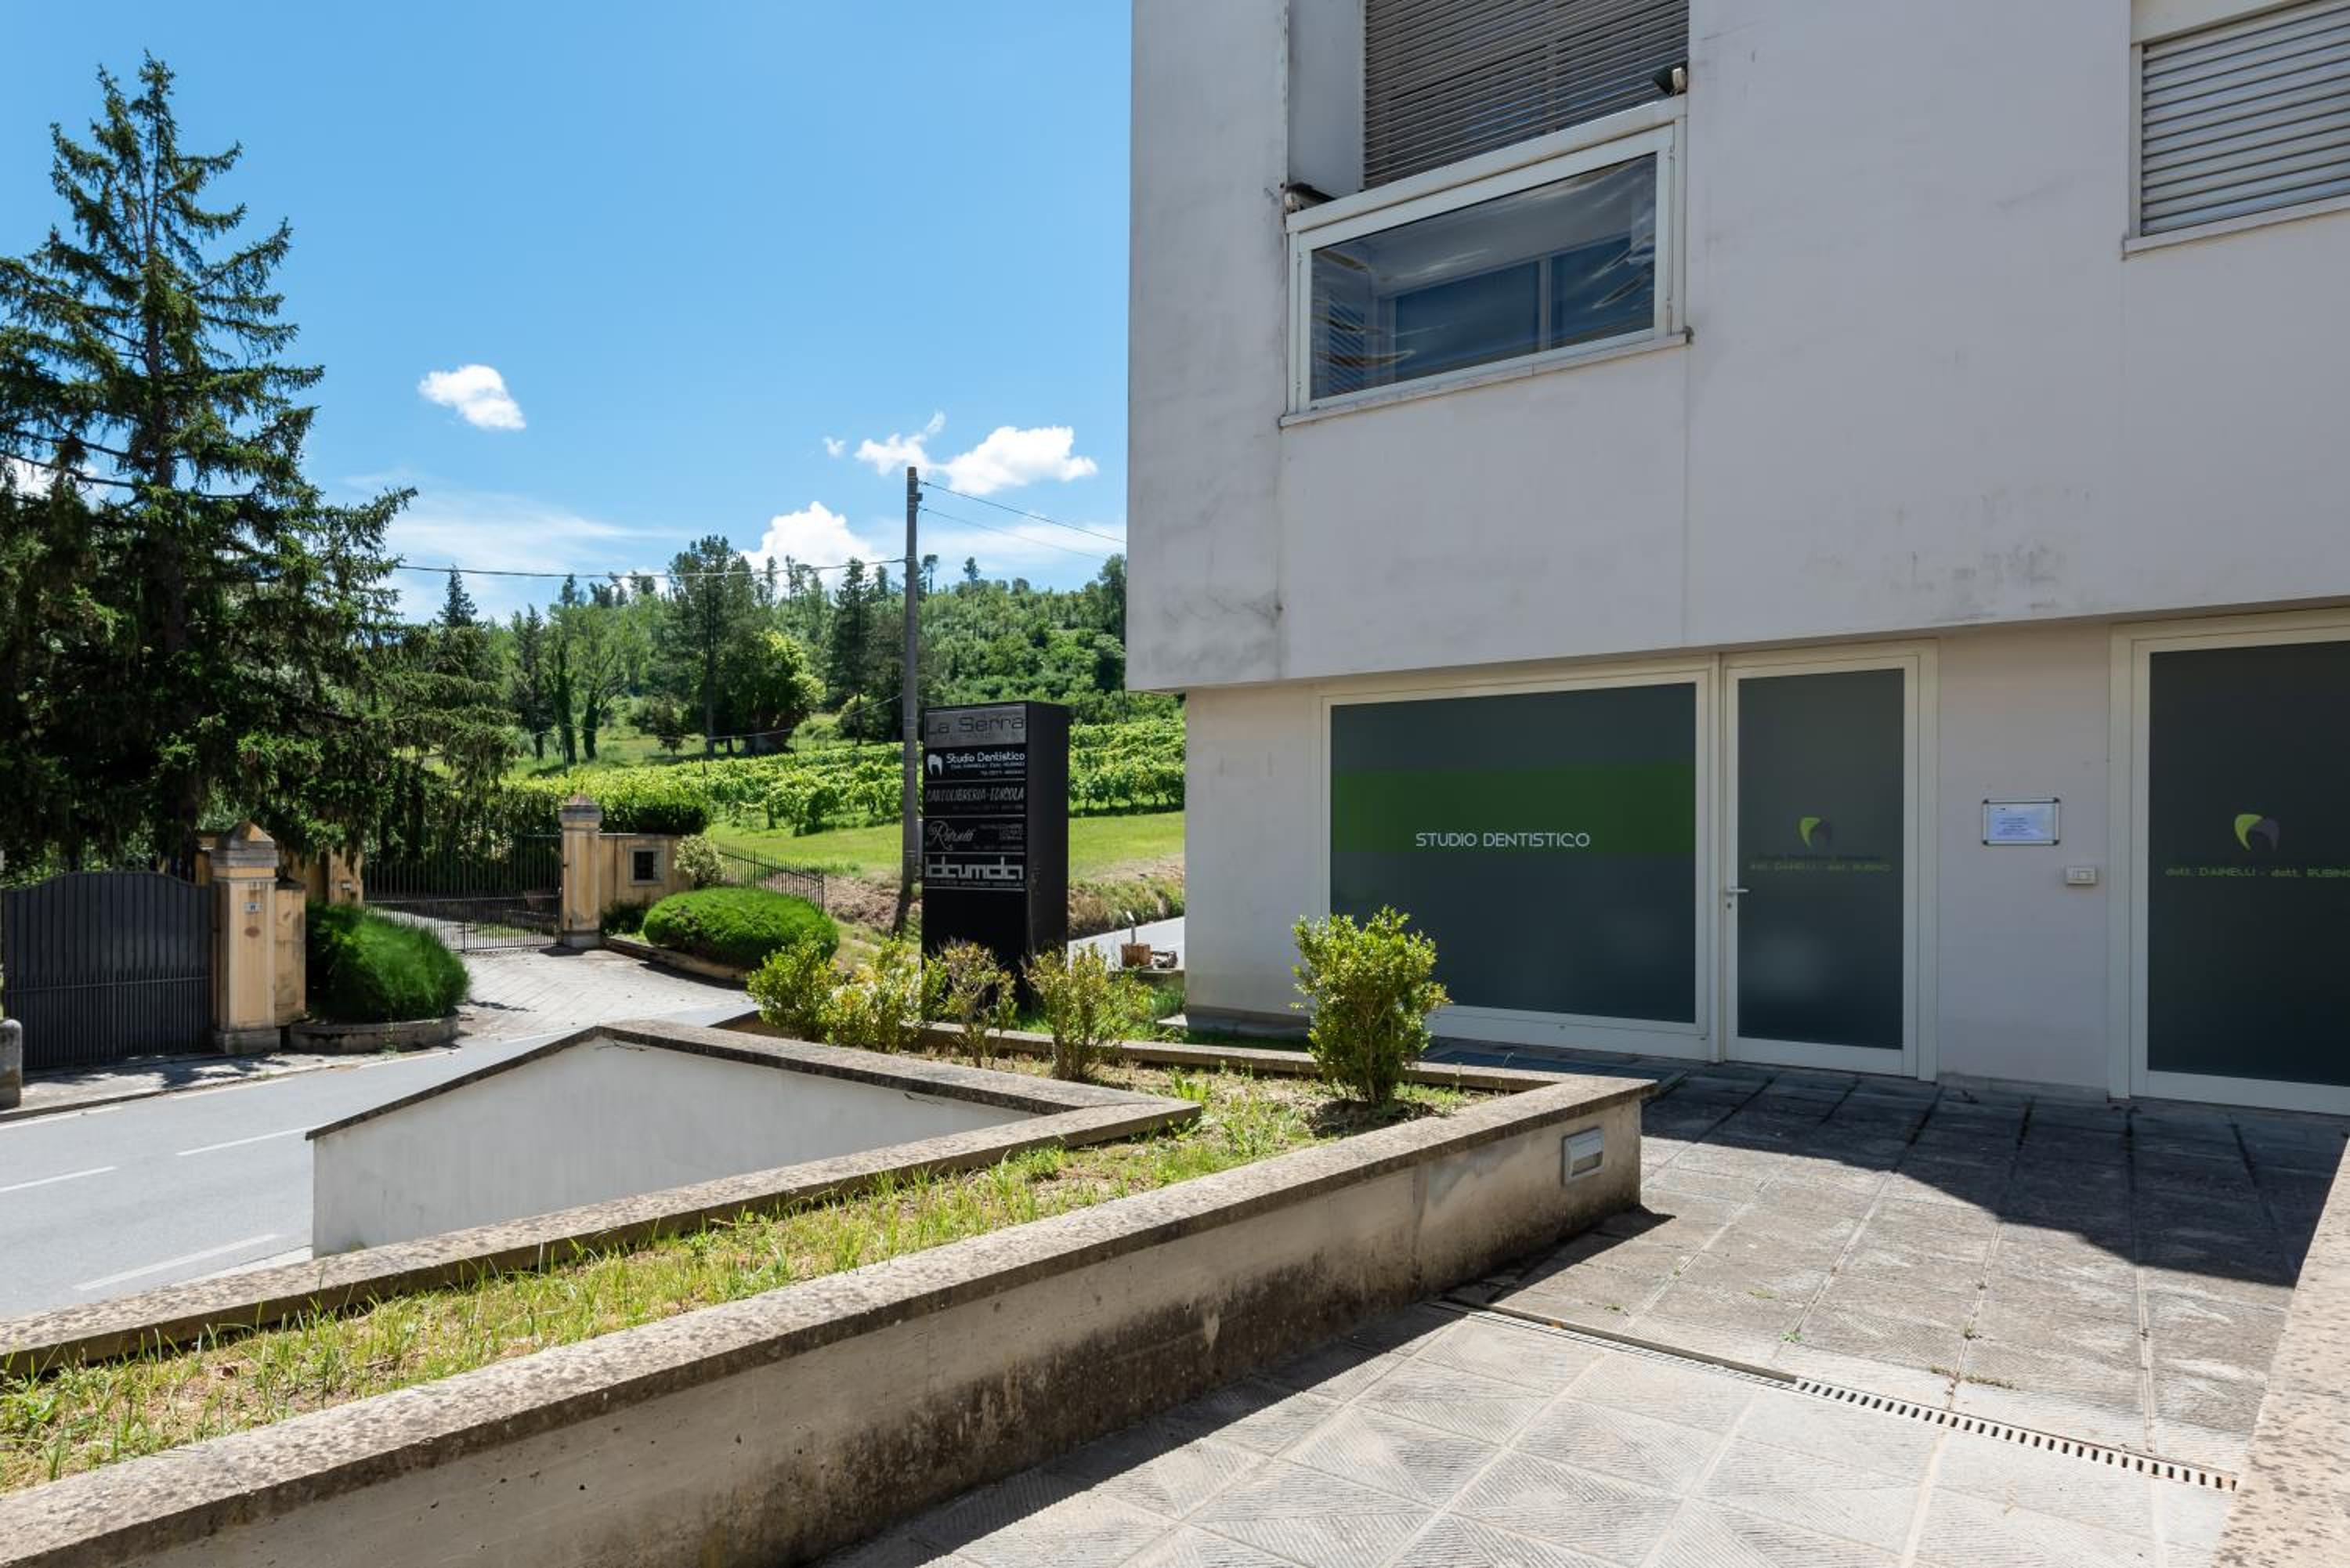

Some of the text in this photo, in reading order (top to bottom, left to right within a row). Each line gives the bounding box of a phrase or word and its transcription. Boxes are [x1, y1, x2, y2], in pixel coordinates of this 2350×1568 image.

[927, 716, 1025, 735] La Serra
[945, 751, 1025, 764] Studio Dentistico
[1415, 833, 1591, 847] STUDIO DENTISTICO
